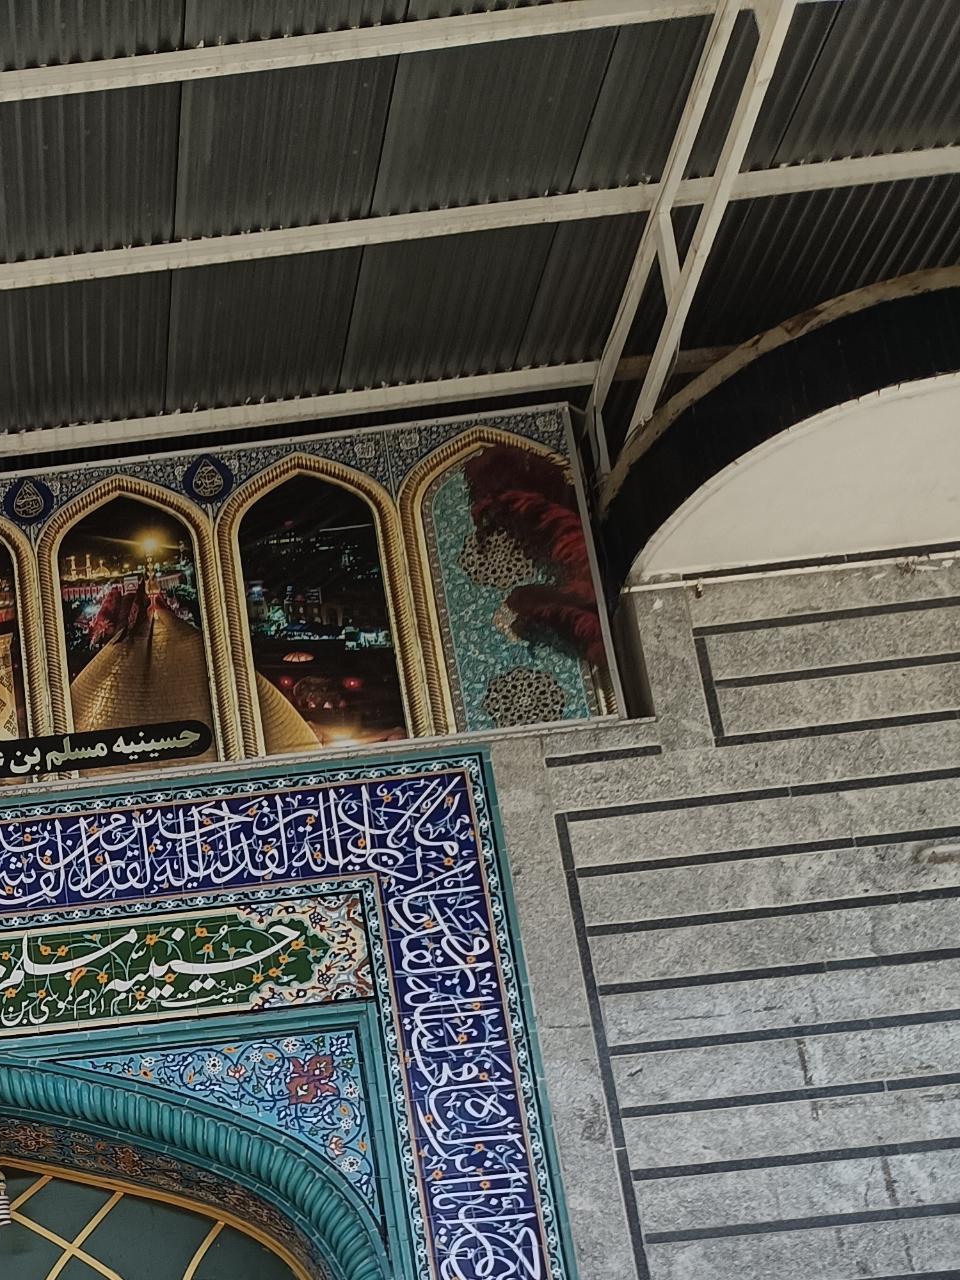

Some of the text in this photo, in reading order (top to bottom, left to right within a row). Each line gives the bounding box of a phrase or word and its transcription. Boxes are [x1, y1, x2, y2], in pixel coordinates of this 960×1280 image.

[9, 746, 41, 774] بن
[45, 736, 107, 770] مسلم
[113, 728, 201, 760] حسینیه
[103, 925, 302, 1000] حسینیه
